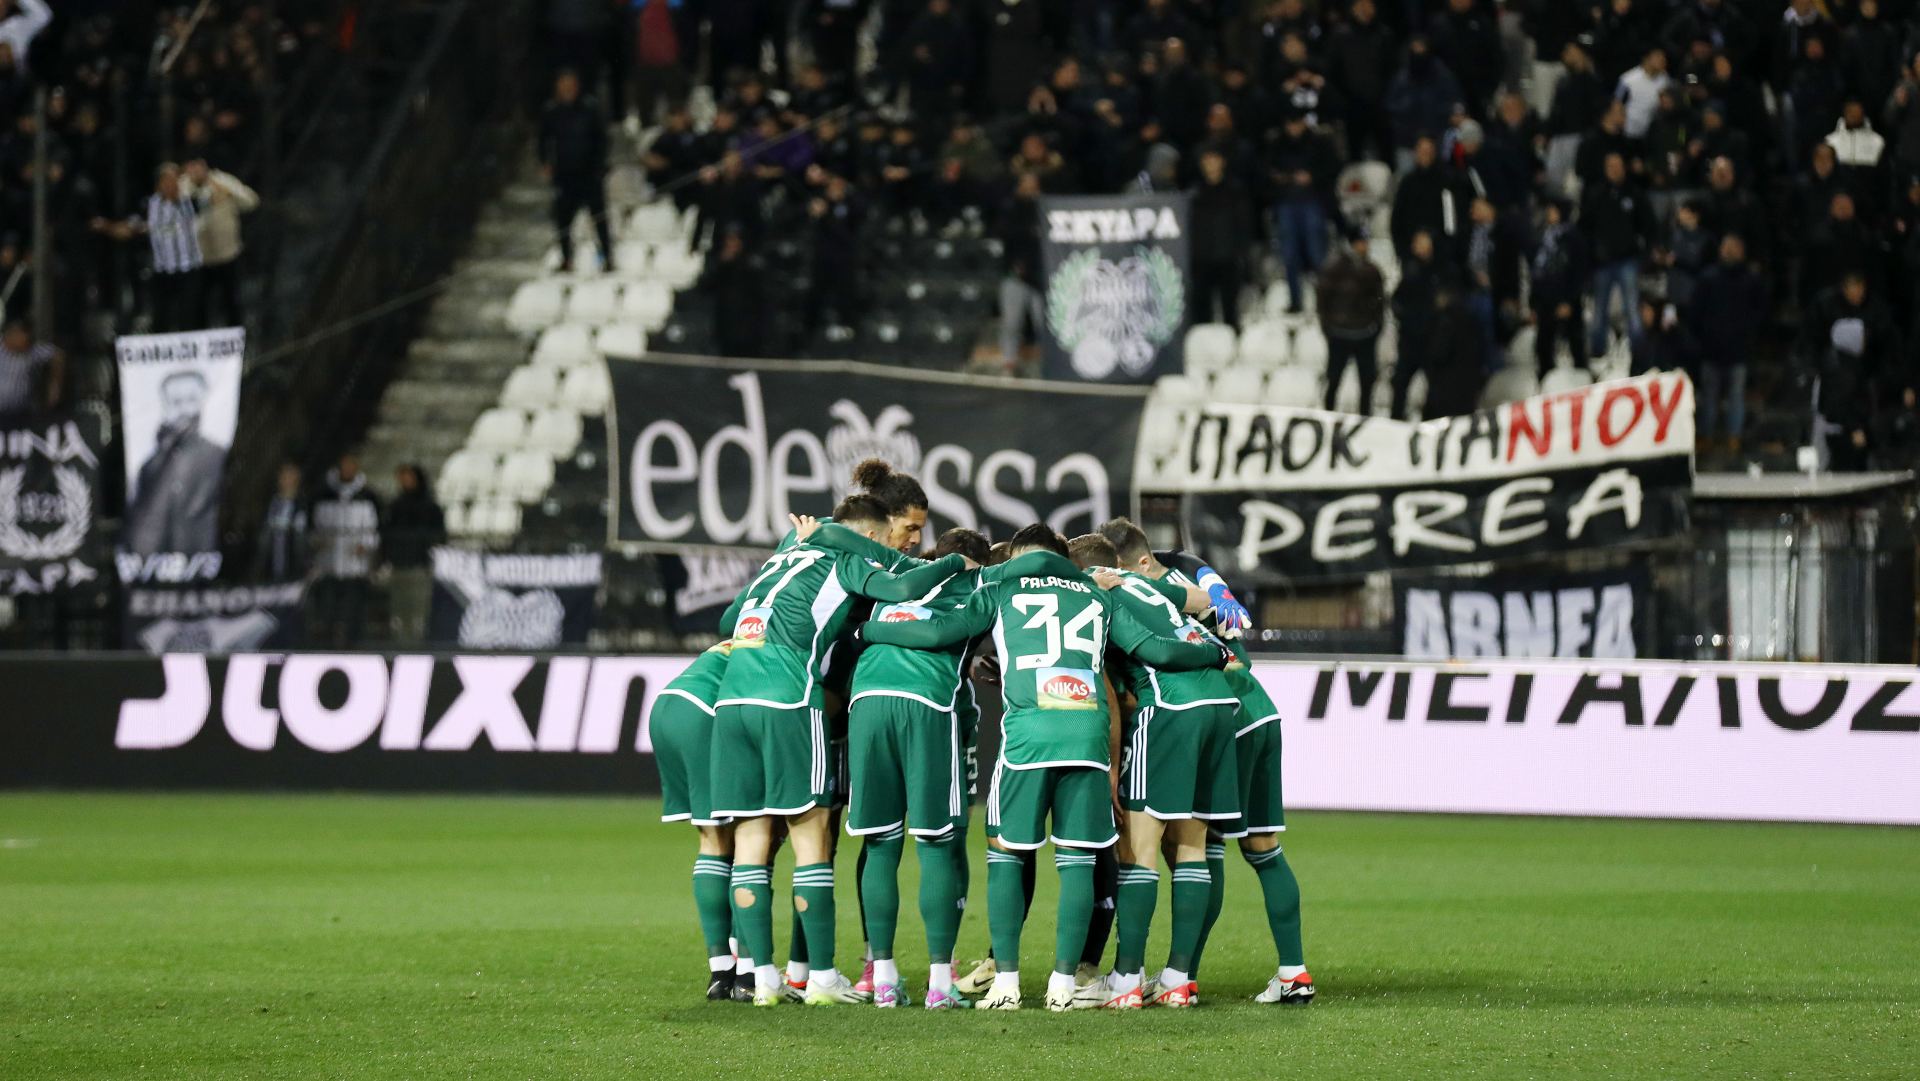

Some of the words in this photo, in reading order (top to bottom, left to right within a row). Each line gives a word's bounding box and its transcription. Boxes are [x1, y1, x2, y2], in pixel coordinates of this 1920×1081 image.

[1188, 411, 1370, 480] ΠΑΟΚ
[1409, 374, 1686, 471] ΠΑΝΤΟΥ
[1238, 467, 1645, 573] PEREA
[1020, 576, 1091, 593] PALACIOS
[1012, 593, 1103, 674] 34
[1046, 682, 1089, 697] NIKAS
